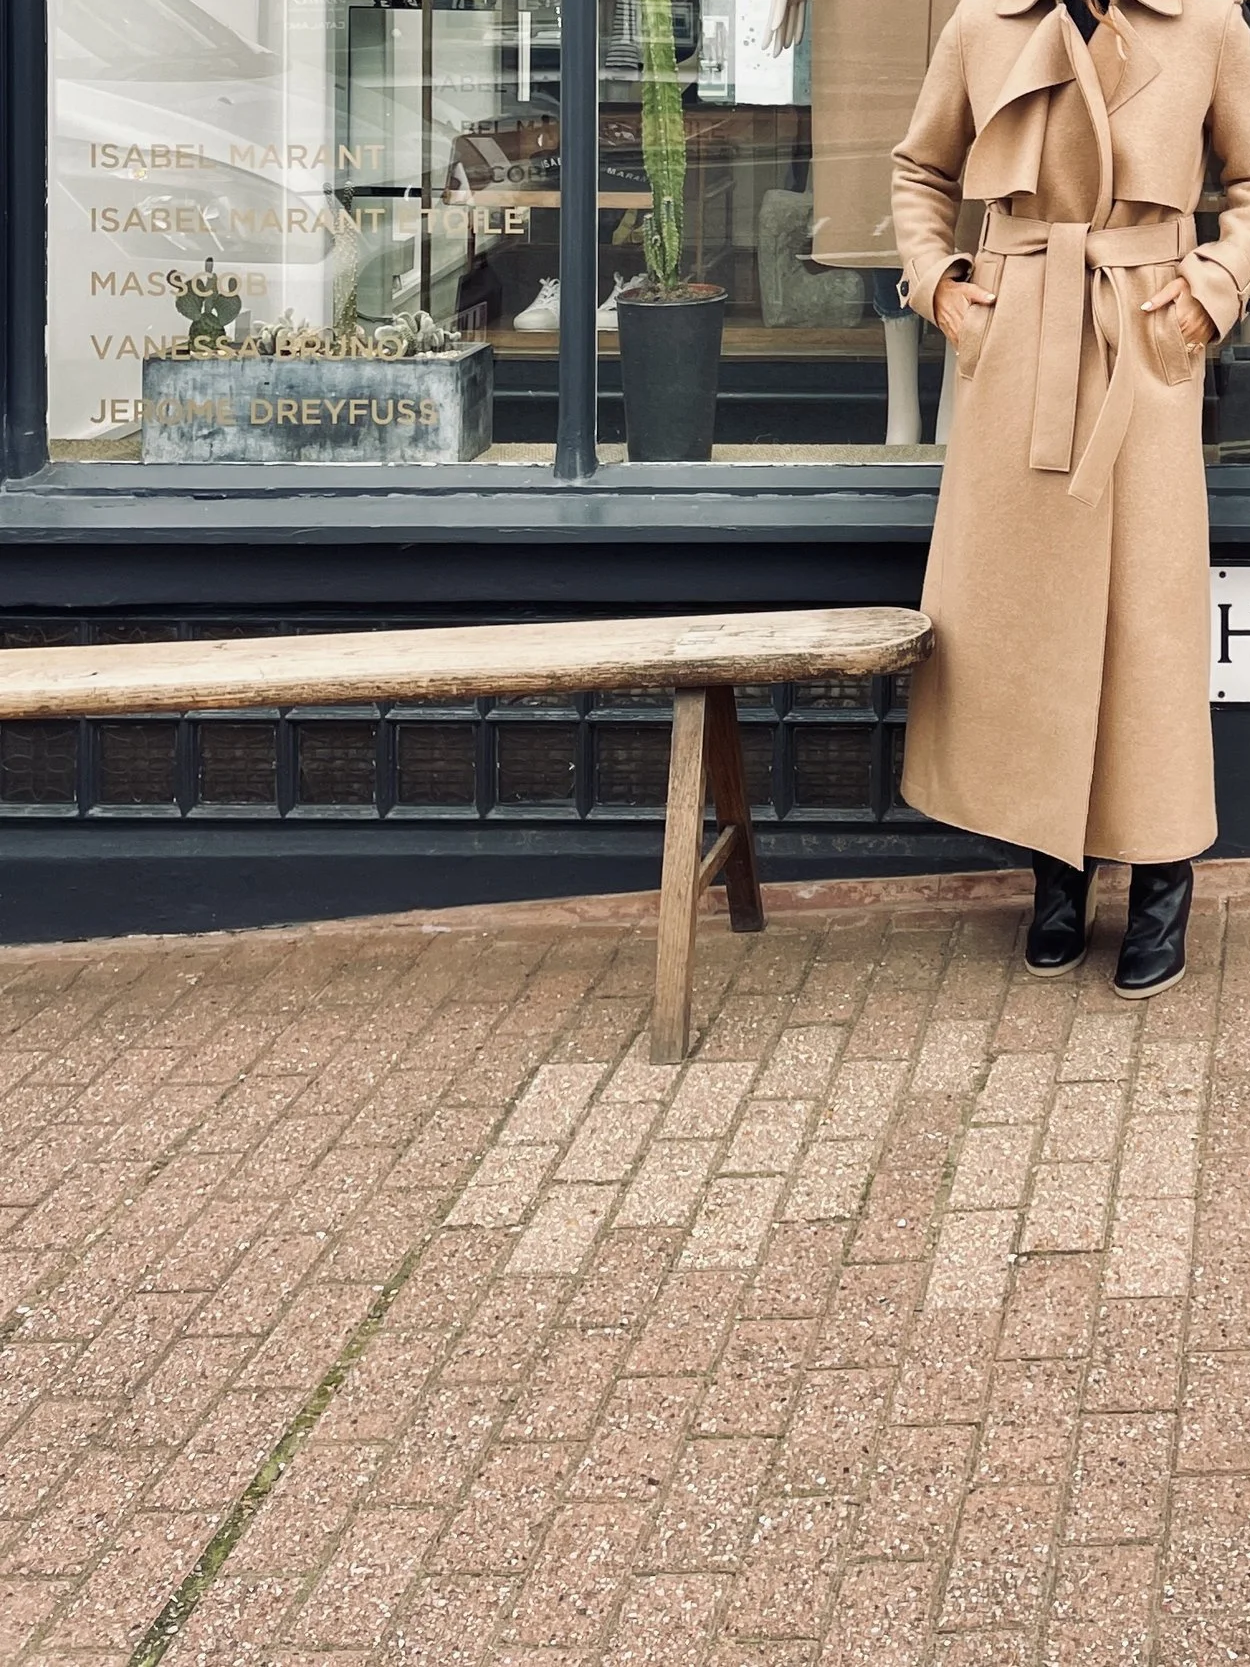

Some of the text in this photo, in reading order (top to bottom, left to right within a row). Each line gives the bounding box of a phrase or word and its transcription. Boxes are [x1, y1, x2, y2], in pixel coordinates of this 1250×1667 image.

[91, 143, 386, 171] ISABEL MARANT
[91, 207, 216, 234] ISABEL
[229, 207, 386, 235] MARANT
[91, 271, 268, 298] MASSCOB
[90, 335, 404, 362] VANESSA BRUNO
[250, 398, 440, 426] DREYFUSS
